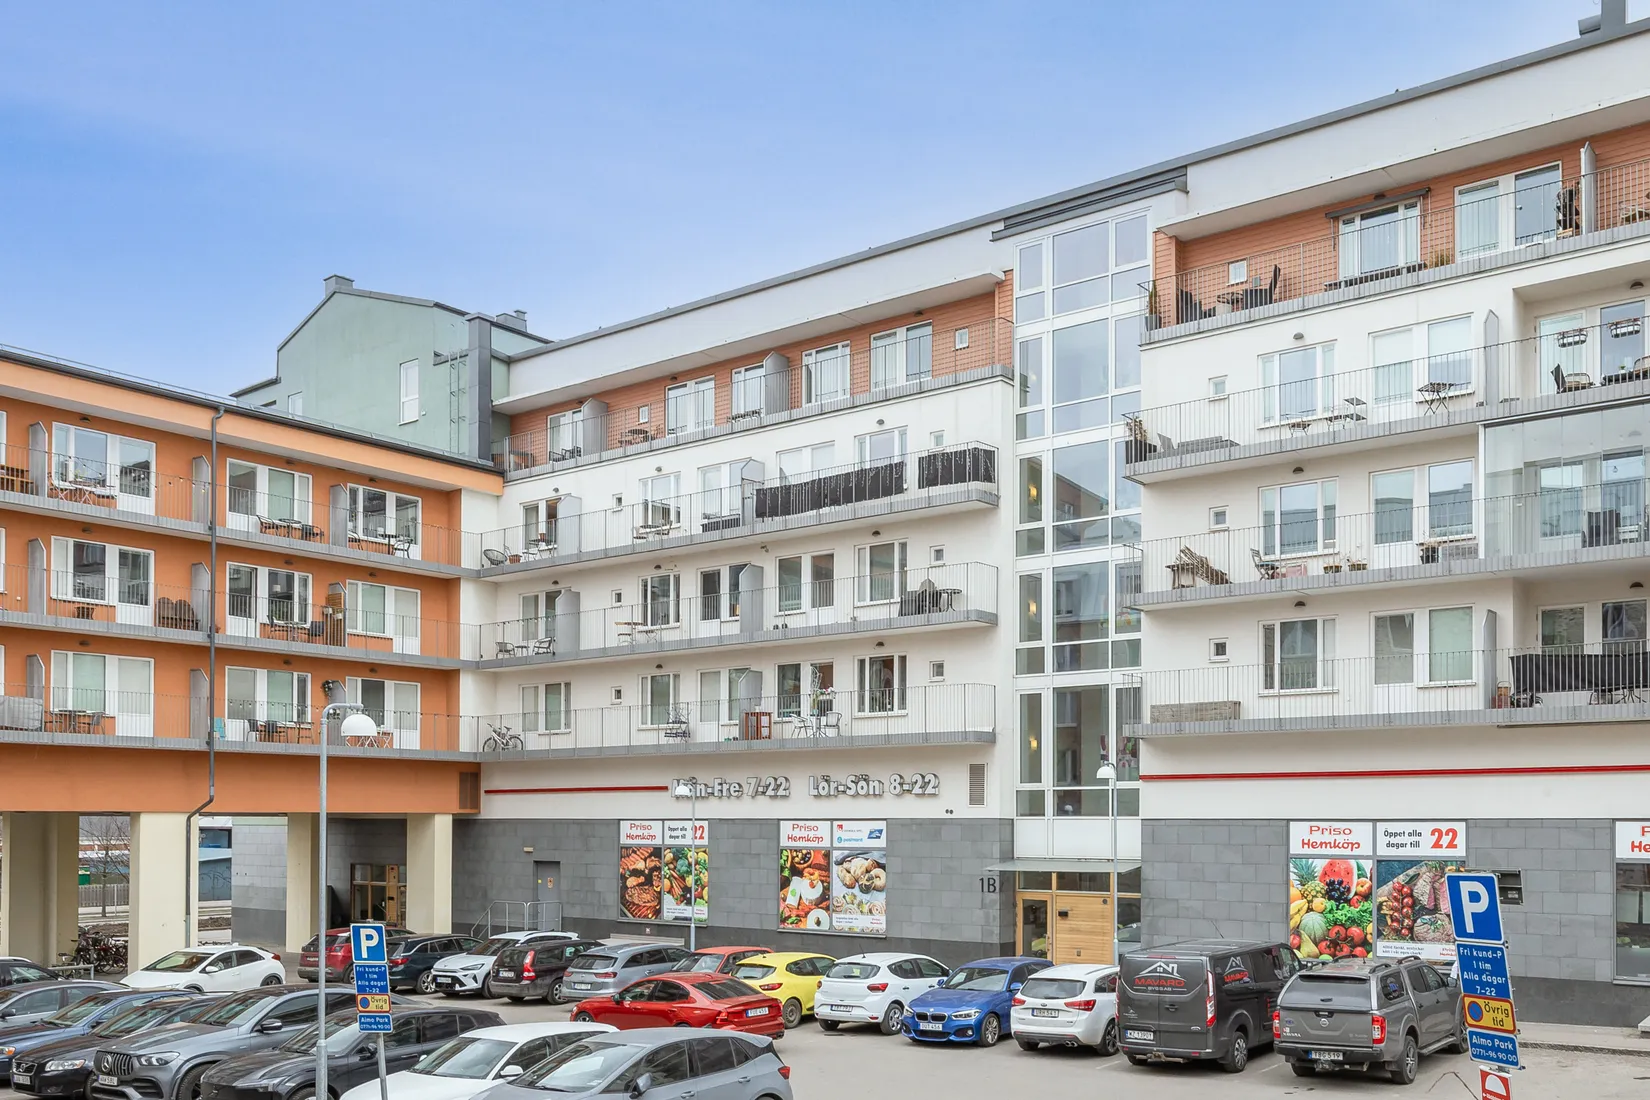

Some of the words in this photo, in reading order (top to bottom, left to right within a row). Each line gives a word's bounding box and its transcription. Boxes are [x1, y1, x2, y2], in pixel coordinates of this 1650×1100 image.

[746, 776, 790, 797] 7-22
[808, 773, 884, 797] Lör-Sön
[889, 773, 940, 796] 8-22
[629, 822, 652, 831] Priso
[792, 823, 819, 832] Priso
[1309, 825, 1352, 835] Priso
[625, 832, 656, 842] Hemköp
[1384, 828, 1406, 838] Öppet
[1407, 829, 1422, 838] alla
[1430, 828, 1458, 849] 22
[787, 834, 823, 844] Hemköp
[1301, 838, 1361, 851] Hemköp
[1386, 840, 1408, 849] dagar
[1409, 841, 1420, 849] till
[979, 877, 997, 893] 1B
[1459, 881, 1490, 933] P
[360, 928, 379, 958] P
[1460, 947, 1471, 956] Fri
[1473, 948, 1502, 959] kund-P
[1479, 961, 1492, 970] tim
[1135, 978, 1185, 987] MAVARD
[1463, 971, 1479, 981] Alla
[1482, 973, 1506, 984] dagar
[1475, 986, 1496, 996] 7-22
[371, 995, 388, 1005] Övrig
[1484, 1001, 1510, 1018] Övrig
[1492, 1016, 1505, 1027] tid
[1472, 1035, 1492, 1047] Almo
[1494, 1038, 1514, 1051] Park
[1471, 1047, 1497, 1059] 0771-96
[1497, 1052, 1507, 1061] 90
[1507, 1054, 1517, 1062] 00
